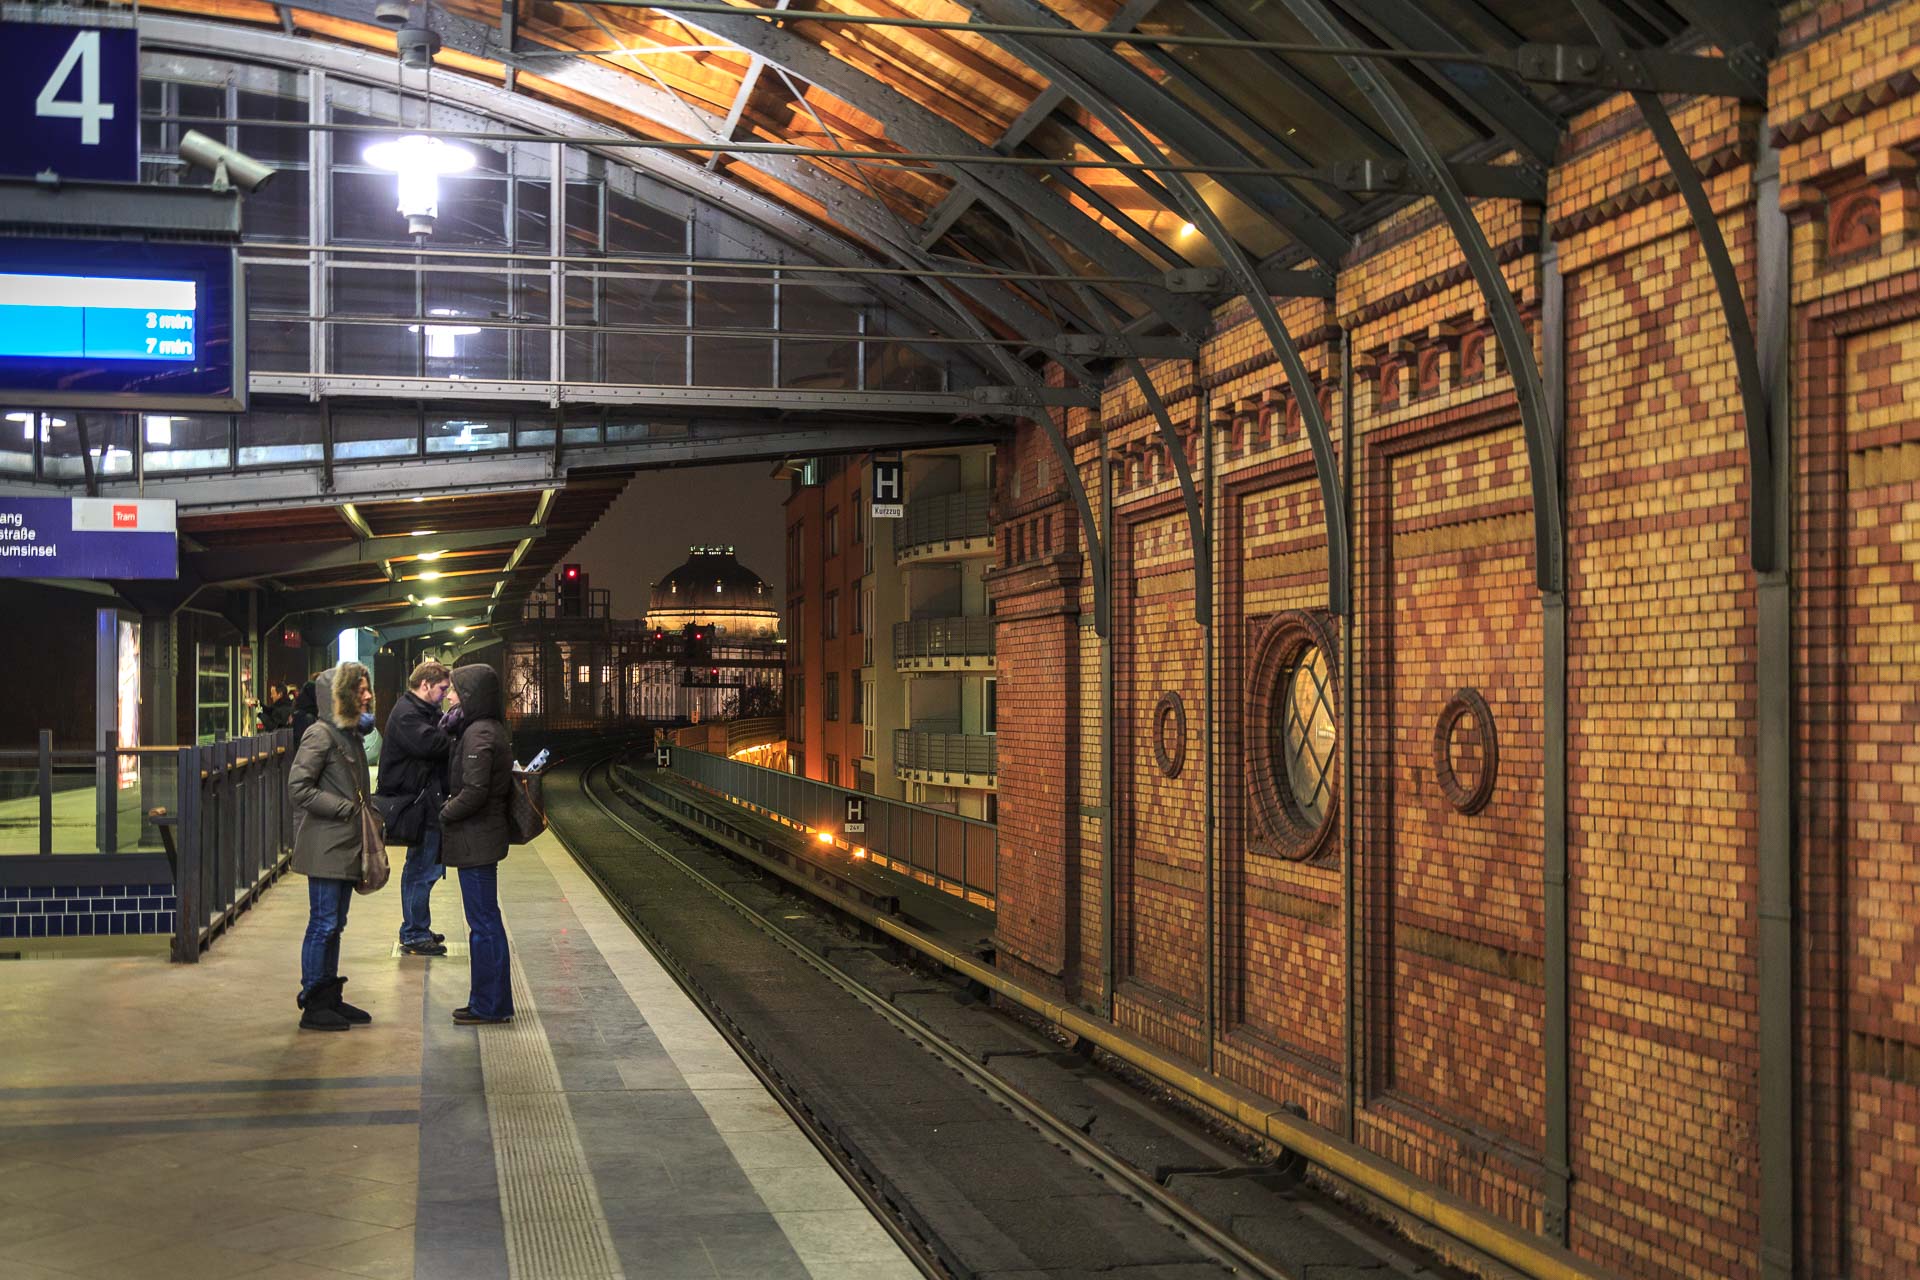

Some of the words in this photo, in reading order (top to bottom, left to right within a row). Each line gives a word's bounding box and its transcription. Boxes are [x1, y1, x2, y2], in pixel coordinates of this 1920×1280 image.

[36, 30, 114, 145] 4
[146, 312, 158, 329] 3
[159, 314, 193, 330] min
[145, 338, 158, 354] 7
[159, 339, 193, 355] min
[877, 468, 898, 498] H
[116, 511, 136, 521] Tram
[874, 506, 901, 517] Kurzzug
[0, 543, 57, 557] umsinsel
[657, 749, 670, 766] H
[848, 800, 862, 820] H
